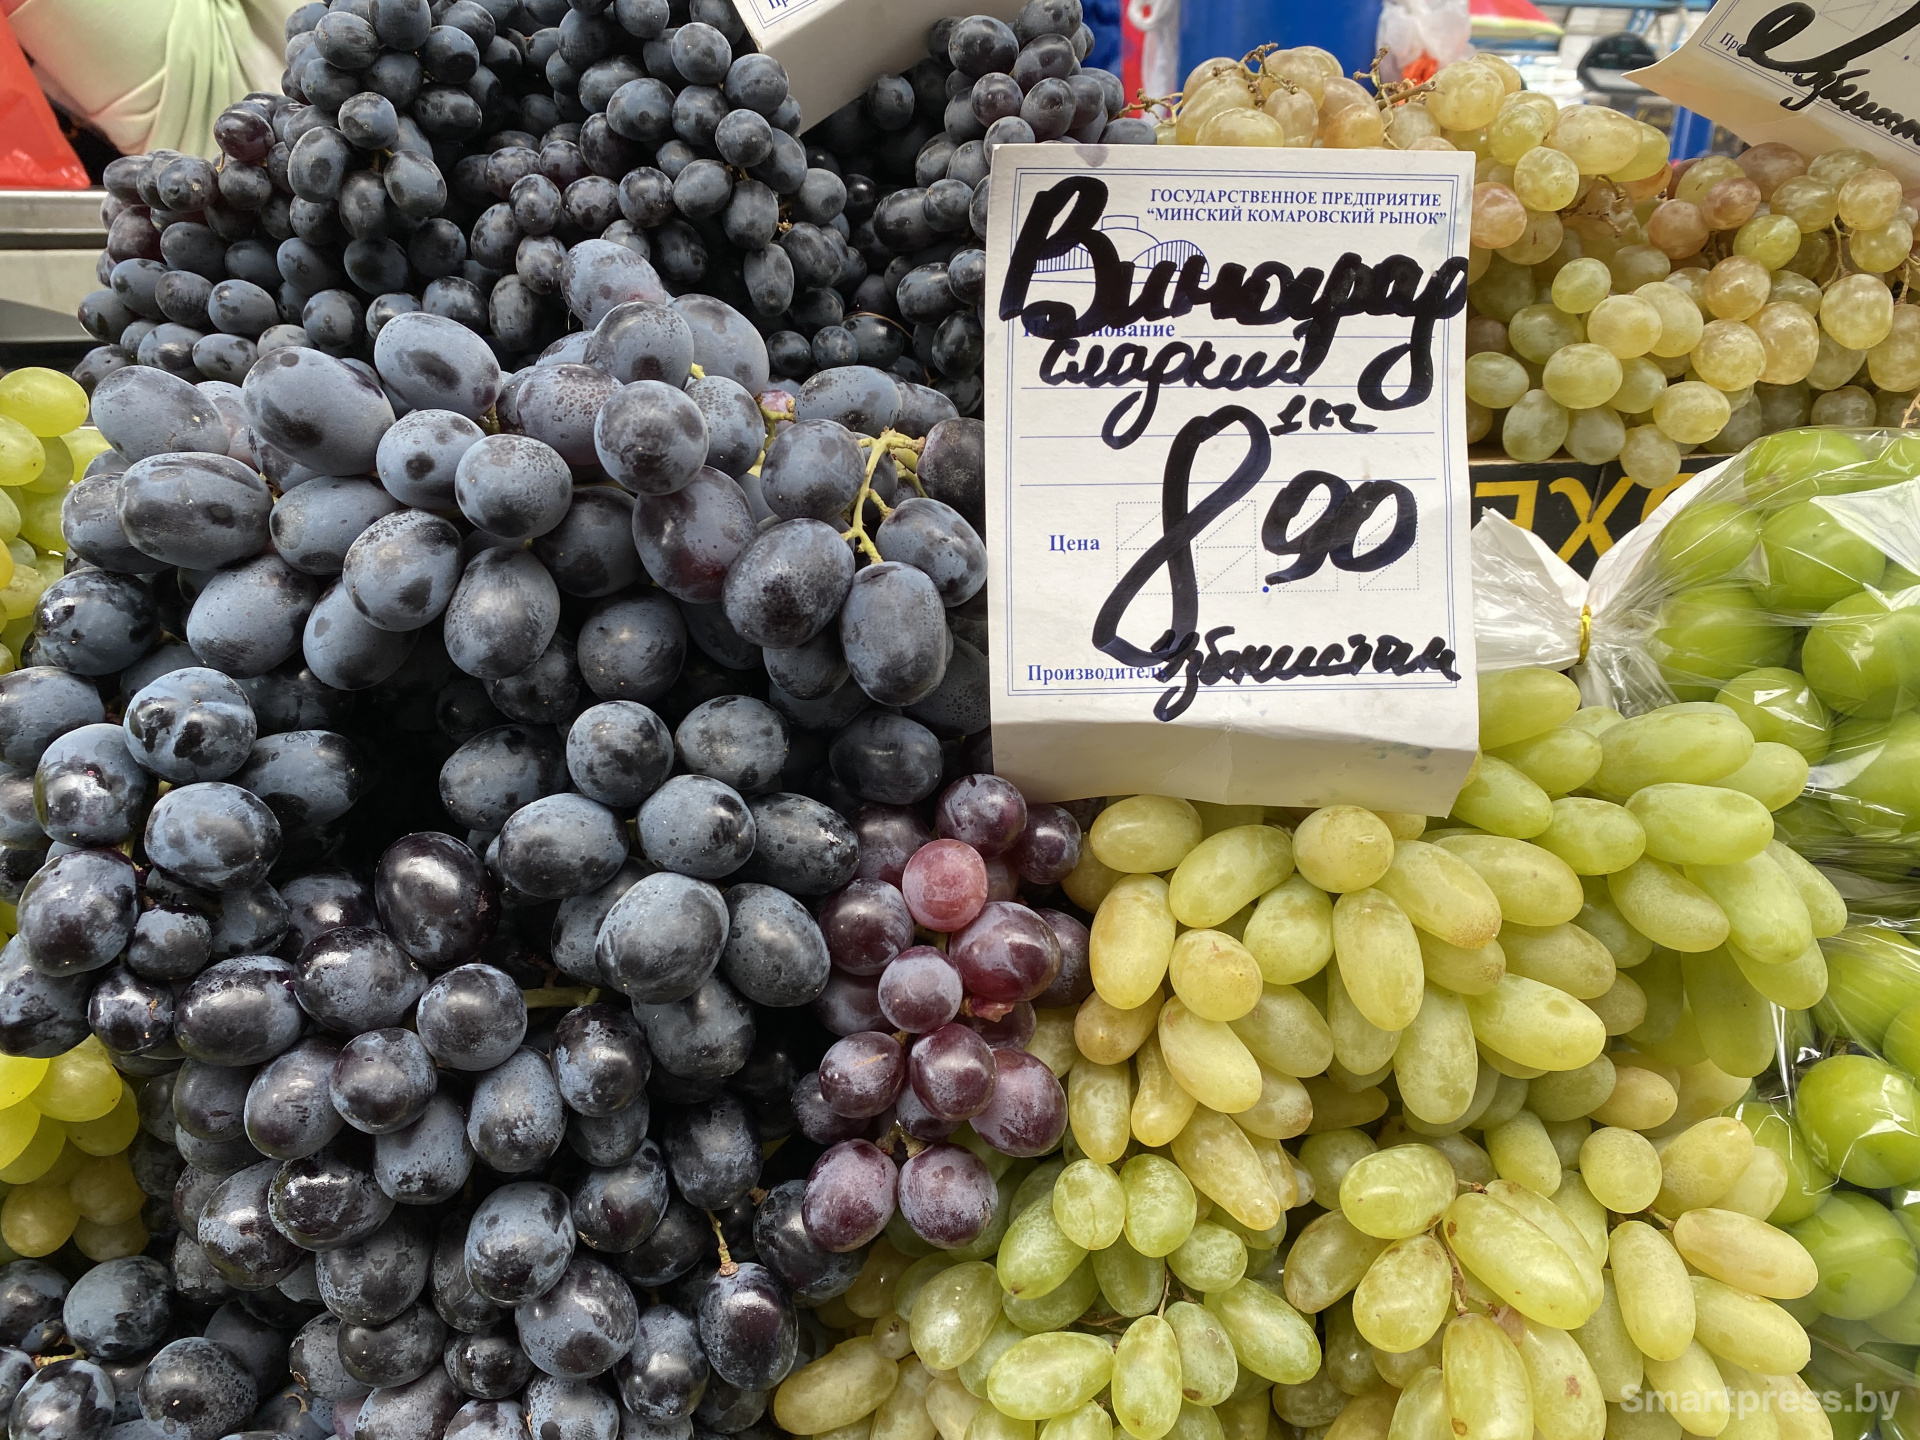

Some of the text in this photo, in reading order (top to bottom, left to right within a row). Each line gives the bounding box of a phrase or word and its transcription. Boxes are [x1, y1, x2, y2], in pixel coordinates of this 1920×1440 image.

[1150, 188, 1442, 208] ГОСУДАРСТВЕННОЕ ПРЕДПРИЯТИЕ
[1247, 207, 1375, 225] КОМАРОВСКИЙ
[1048, 534, 1100, 554] Цена
[1027, 664, 1167, 686] Производитель
